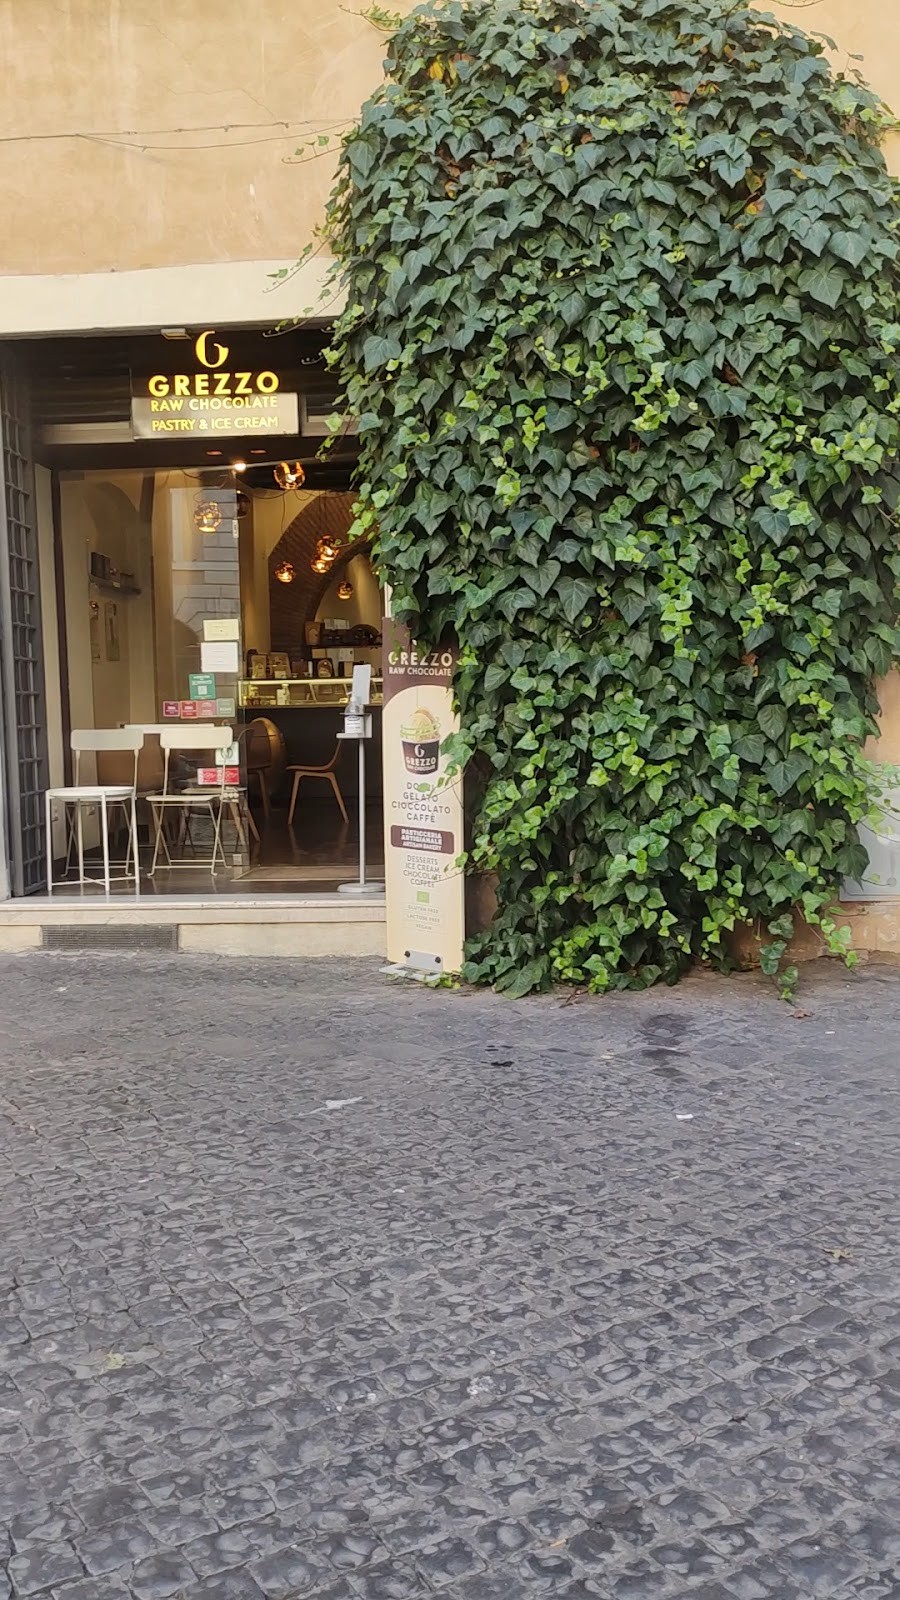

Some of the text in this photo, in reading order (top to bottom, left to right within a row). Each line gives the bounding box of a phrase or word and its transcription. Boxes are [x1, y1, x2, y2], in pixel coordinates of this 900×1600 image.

[148, 371, 279, 397] GREZZO
[150, 396, 278, 412] RAW CHOCOLATE
[151, 416, 278, 432] PASTRY & ICE CREAM
[388, 666, 452, 677] RAW CHOCOLATE
[391, 800, 451, 814] CIOCCOLATO
[406, 811, 435, 823] CAFFÈ
[407, 854, 437, 865] DESSERTS
[405, 862, 440, 873] ICE CREAM
